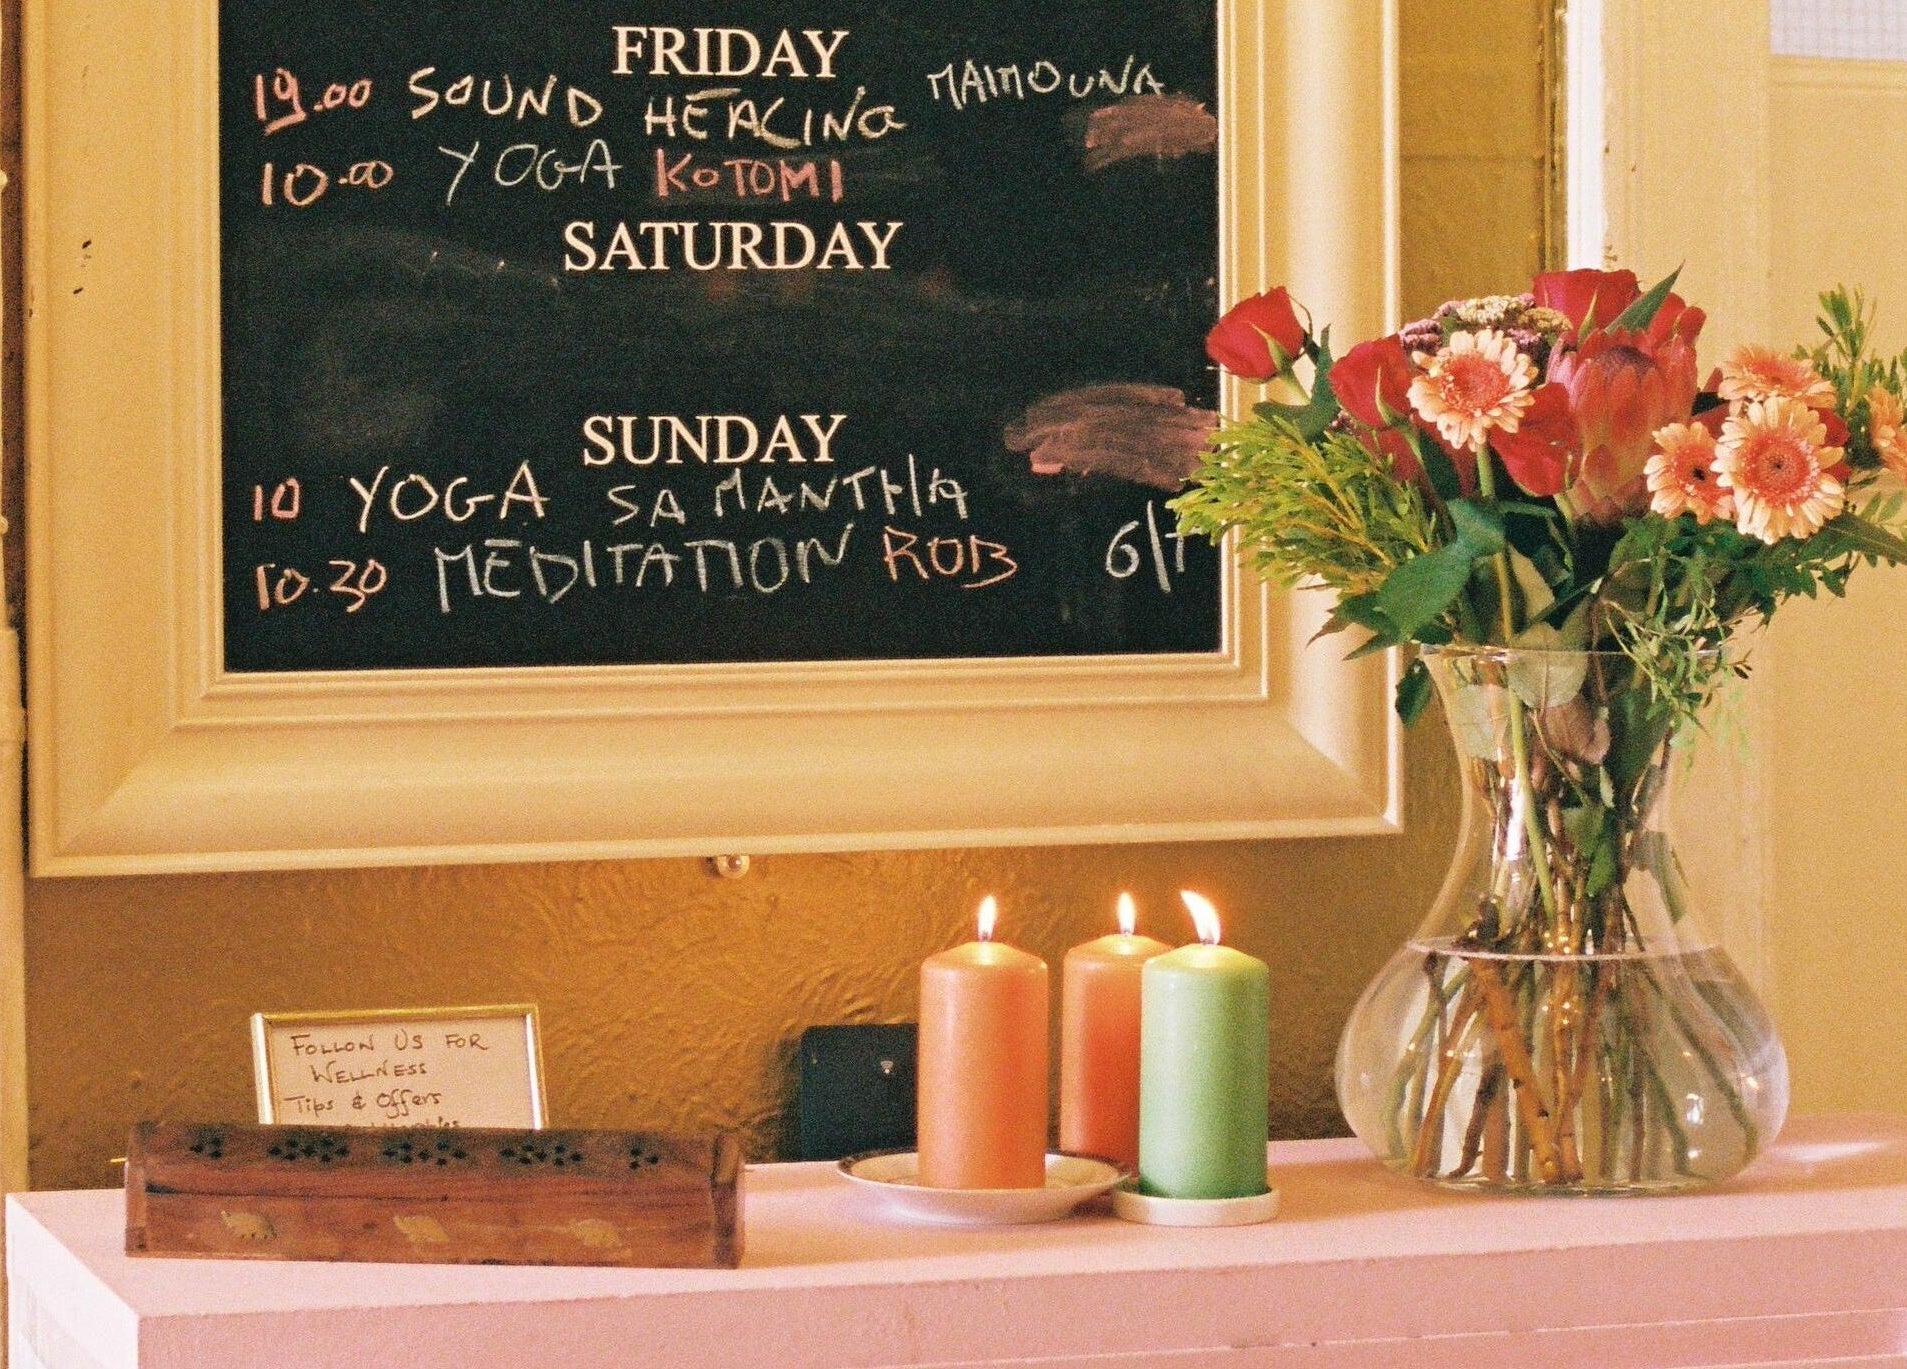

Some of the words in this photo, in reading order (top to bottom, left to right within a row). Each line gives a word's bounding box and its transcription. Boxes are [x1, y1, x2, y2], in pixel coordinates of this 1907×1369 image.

[612, 25, 849, 78] FRIDAY
[254, 67, 373, 135] 19.00
[408, 66, 604, 128] SOUND
[644, 85, 906, 150] HEALING
[261, 160, 394, 206] 10.00
[437, 138, 624, 207] YOGA
[563, 220, 904, 272] SATURDAY
[582, 414, 848, 466] SUNDAY
[252, 476, 301, 523] 10
[349, 460, 551, 534] YOGA
[434, 522, 856, 614] MEDITATION
[883, 525, 1019, 590] ROB
[394, 1029, 424, 1051] US
[445, 1033, 490, 1051] FOR
[310, 1060, 428, 1084] WELLNESS
[284, 1095, 335, 1118] Tips
[376, 1088, 443, 1120] Offers
